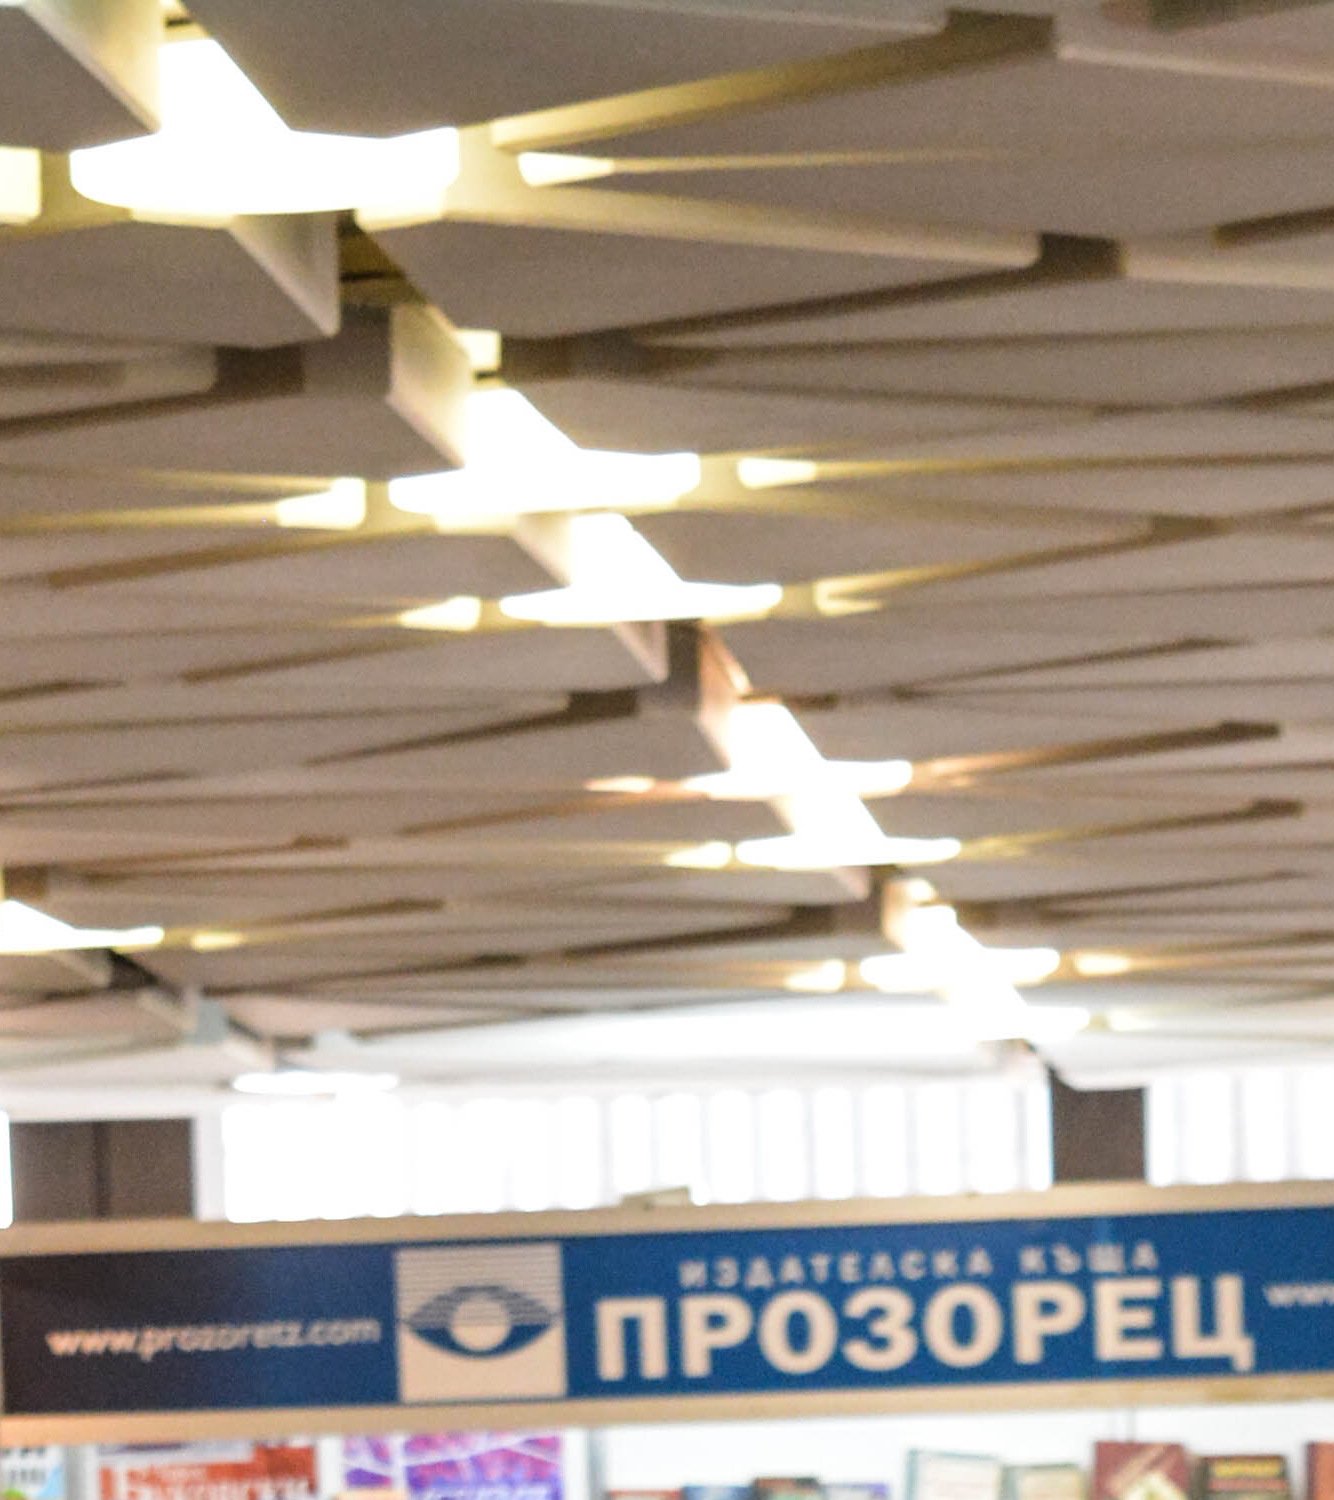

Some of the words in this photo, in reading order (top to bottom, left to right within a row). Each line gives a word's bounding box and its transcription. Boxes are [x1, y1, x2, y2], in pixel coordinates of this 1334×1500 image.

[679, 1246, 994, 1289] ИЗДАТЕЛСКА
[1019, 1240, 1160, 1276] КЪЩА
[45, 1316, 381, 1362] www.prozoretz.com
[594, 1273, 1255, 1382] ПРОЗОРЕЦ
